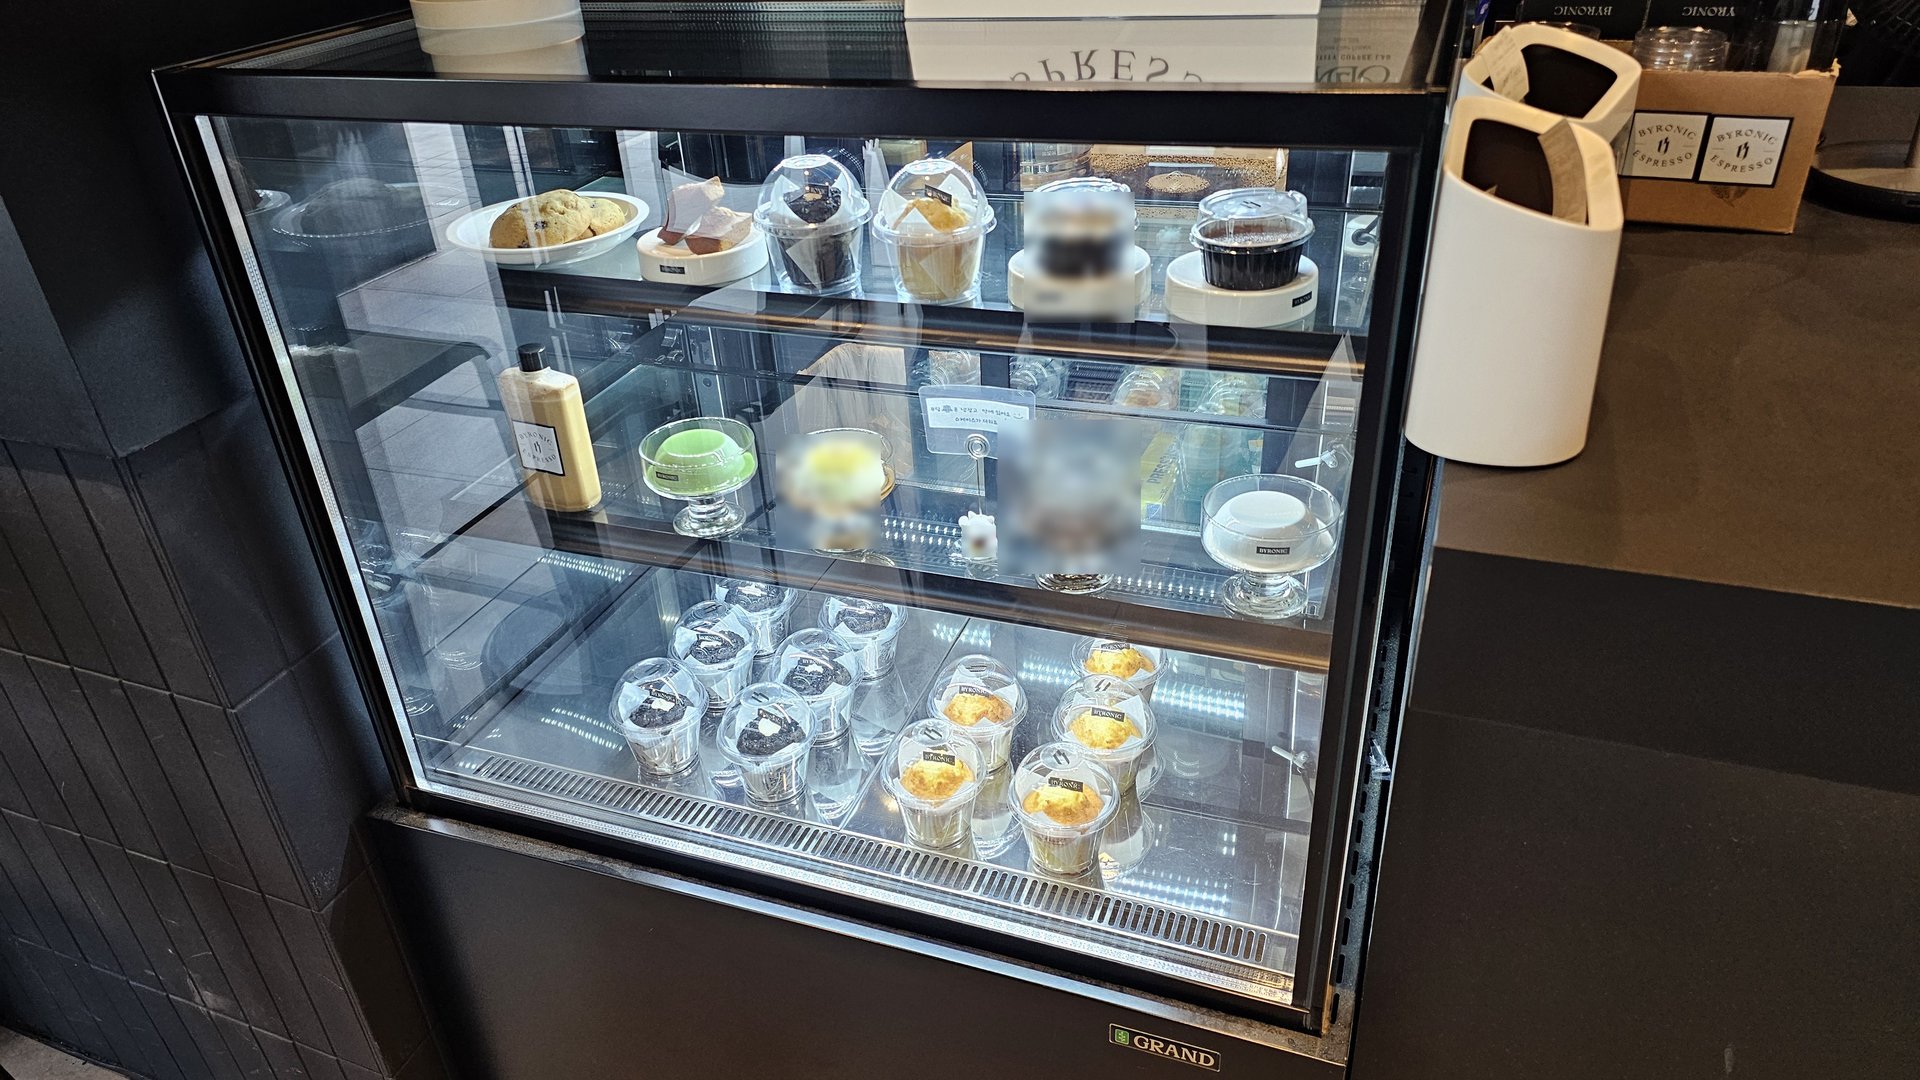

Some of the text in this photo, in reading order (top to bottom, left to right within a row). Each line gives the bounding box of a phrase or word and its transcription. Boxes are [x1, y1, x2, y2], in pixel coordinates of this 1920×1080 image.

[1554, 6, 1612, 16] BYRONIC
[1682, 6, 1736, 17] YRONIC
[1638, 124, 1697, 140] BYRONIC
[1716, 129, 1778, 146] BYRONIC
[1632, 149, 1693, 168] ESPRESSO
[1710, 154, 1774, 174] ESPRESSO
[1133, 1035, 1215, 1067] GRAND
